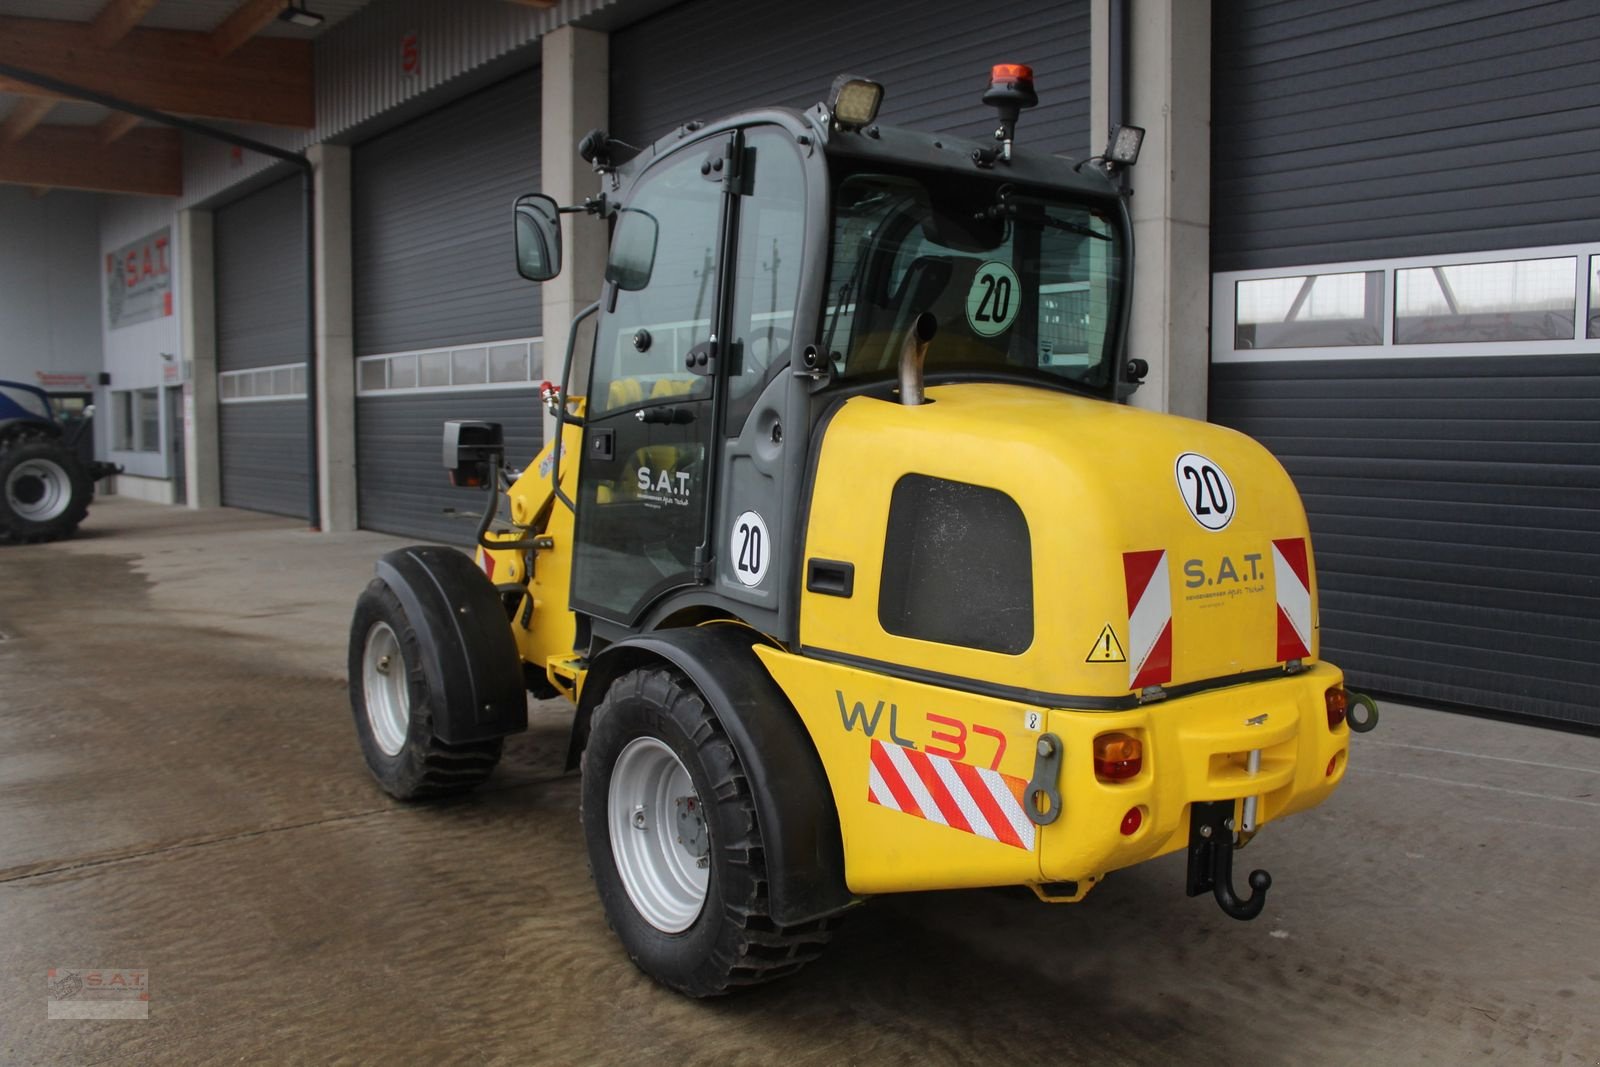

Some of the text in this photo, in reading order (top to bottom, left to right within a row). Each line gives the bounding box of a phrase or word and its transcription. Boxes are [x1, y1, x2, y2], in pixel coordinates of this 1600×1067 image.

[975, 274, 1011, 323] 20
[637, 466, 690, 496] S.A.T.
[1183, 465, 1228, 515] 20
[738, 523, 761, 574] 20
[1183, 553, 1264, 589] S.A.T.
